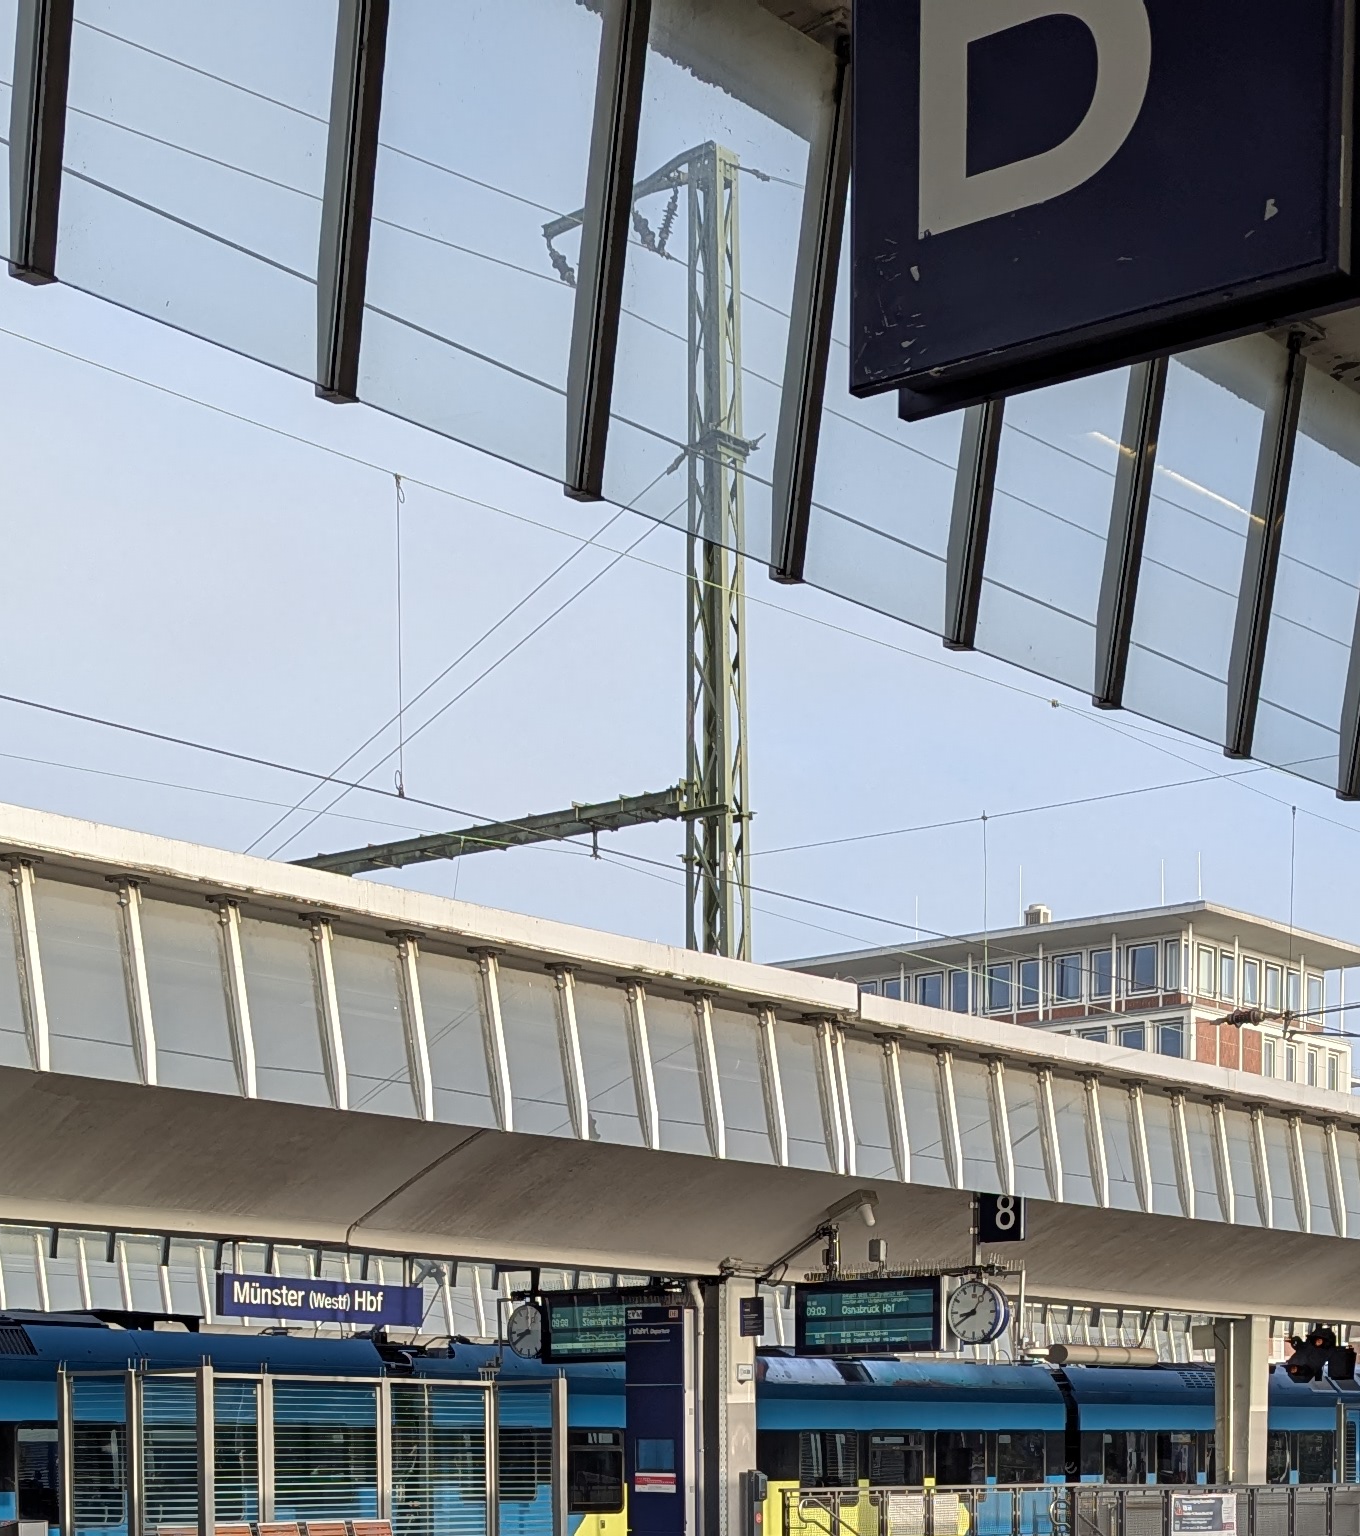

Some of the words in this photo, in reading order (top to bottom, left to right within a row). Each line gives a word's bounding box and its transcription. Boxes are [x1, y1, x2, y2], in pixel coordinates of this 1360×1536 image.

[995, 1195, 1016, 1231] 8
[233, 1281, 306, 1307] Münster
[309, 1290, 350, 1312] (Westf)
[354, 1289, 384, 1312] Hbf
[842, 1304, 880, 1315] Osnabrück
